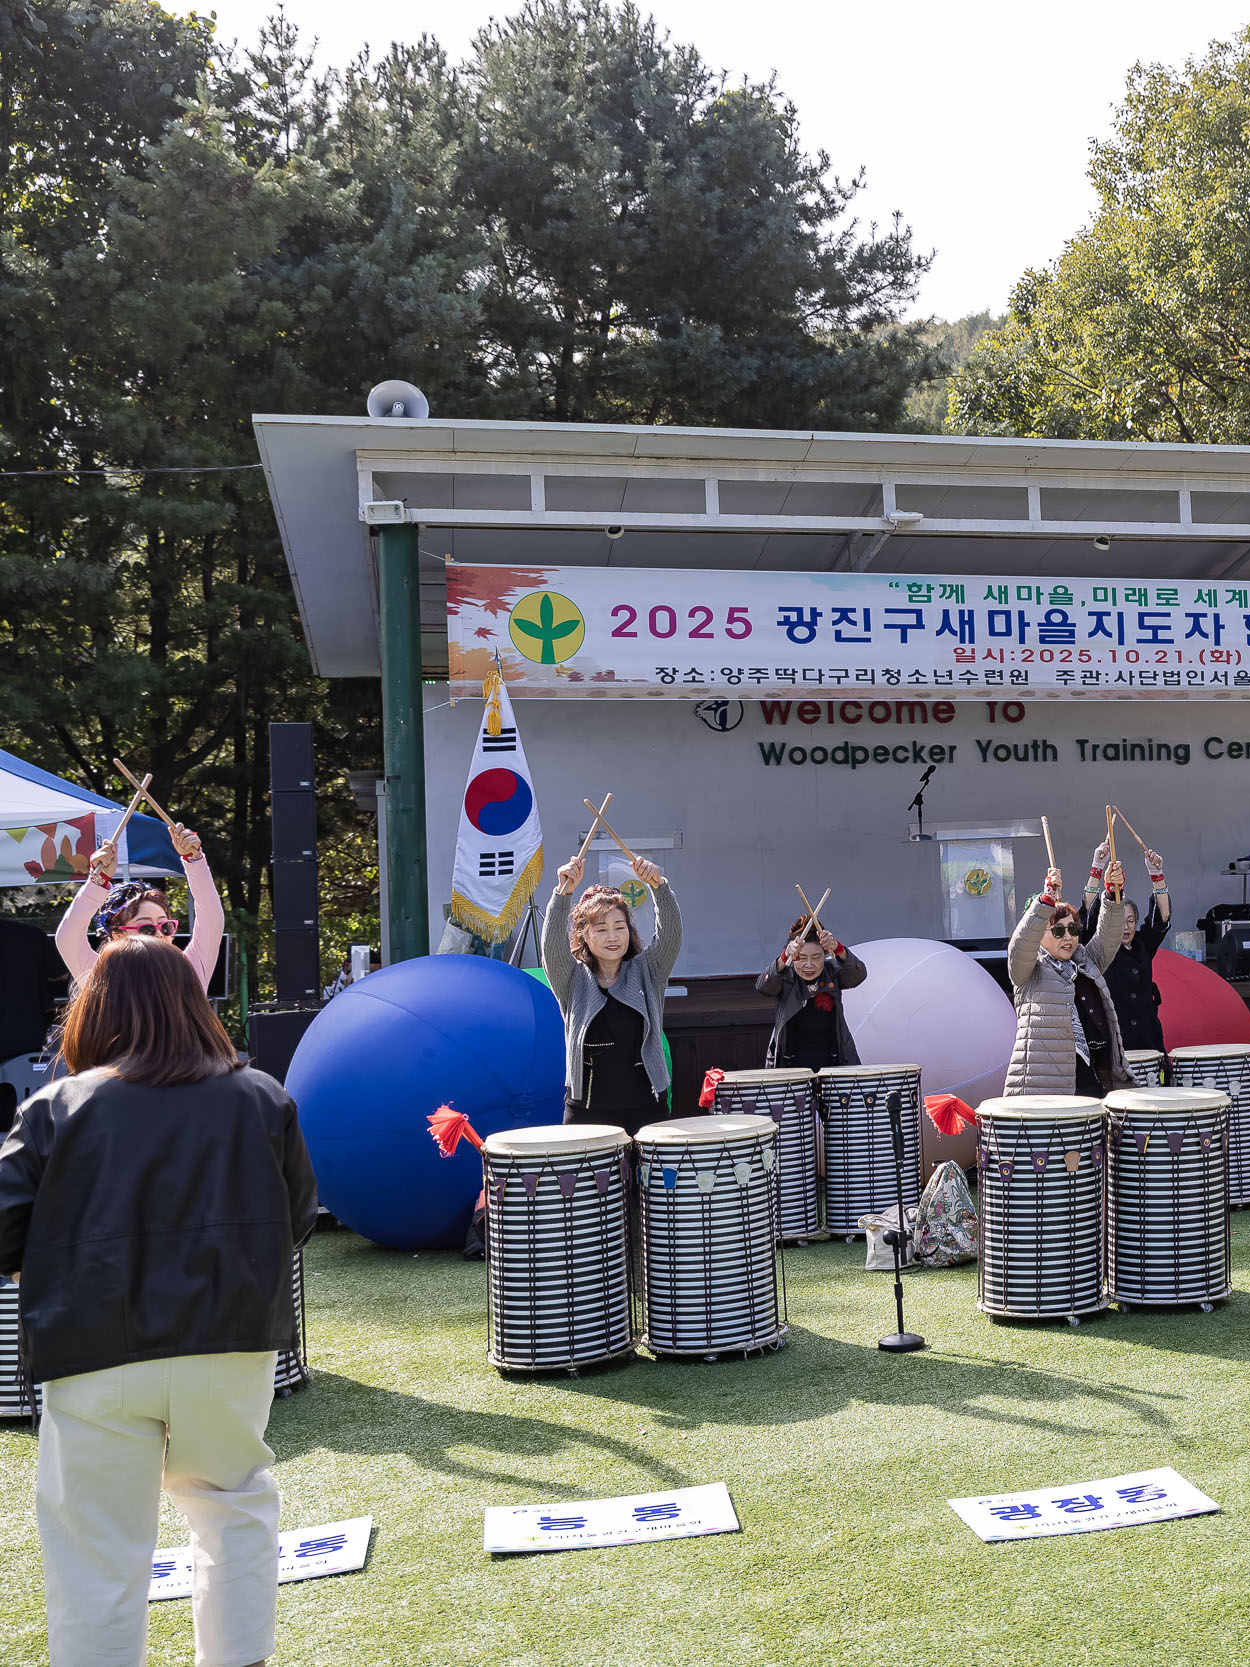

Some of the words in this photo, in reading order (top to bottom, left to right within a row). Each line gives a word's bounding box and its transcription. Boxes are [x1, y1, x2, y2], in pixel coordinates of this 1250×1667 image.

[889, 581, 965, 604] “함께
[610, 604, 753, 639] 2025
[776, 606, 1226, 646] 광진구새마을지도자
[759, 700, 956, 725] Welcome
[758, 740, 957, 769] Woodpecker
[975, 739, 1058, 763] Youth
[1075, 738, 1191, 765] Training
[989, 1483, 1168, 1521] 광장동
